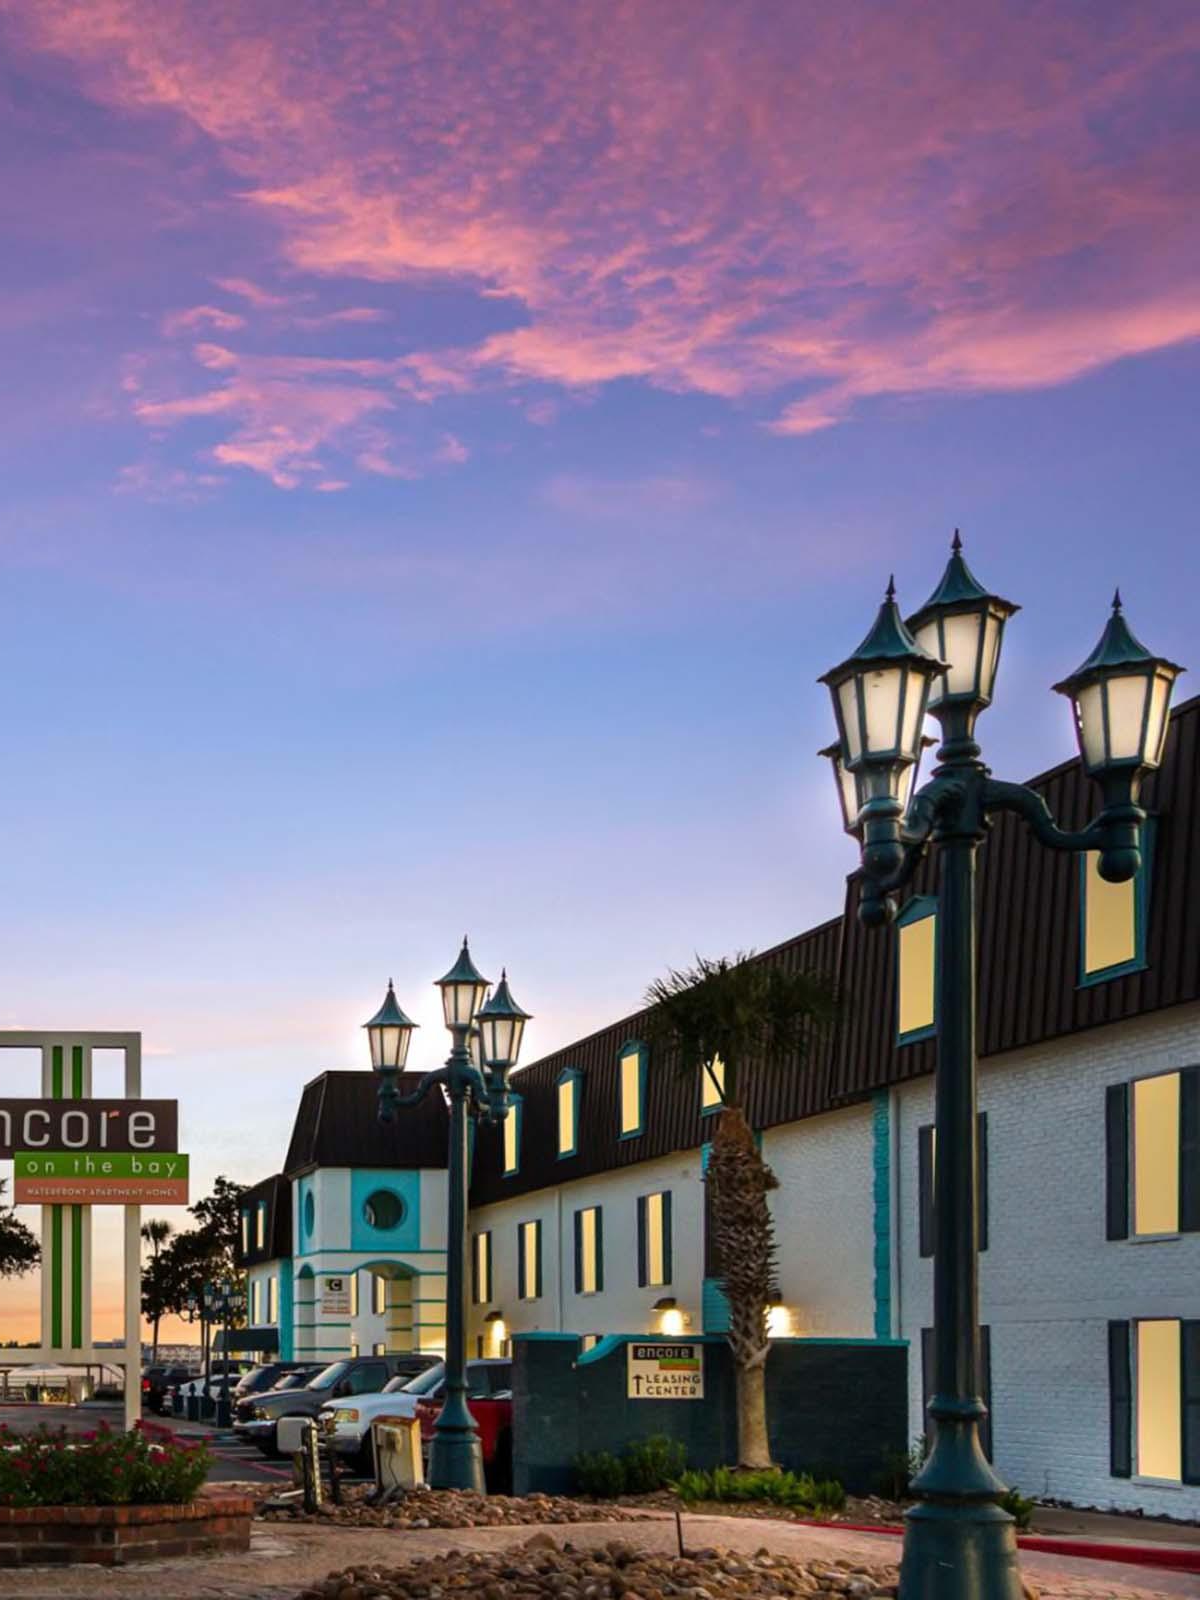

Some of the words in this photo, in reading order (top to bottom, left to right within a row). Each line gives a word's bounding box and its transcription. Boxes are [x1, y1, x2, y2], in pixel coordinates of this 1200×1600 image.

[27, 1160, 55, 1173] on
[74, 1155, 112, 1173] the
[132, 1155, 176, 1178] bay
[89, 1188, 143, 1196] APARTMENT
[146, 1188, 178, 1196] HOMES
[637, 1347, 689, 1358] encore
[646, 1374, 701, 1384] LEASING
[646, 1386, 697, 1395] CENTER
